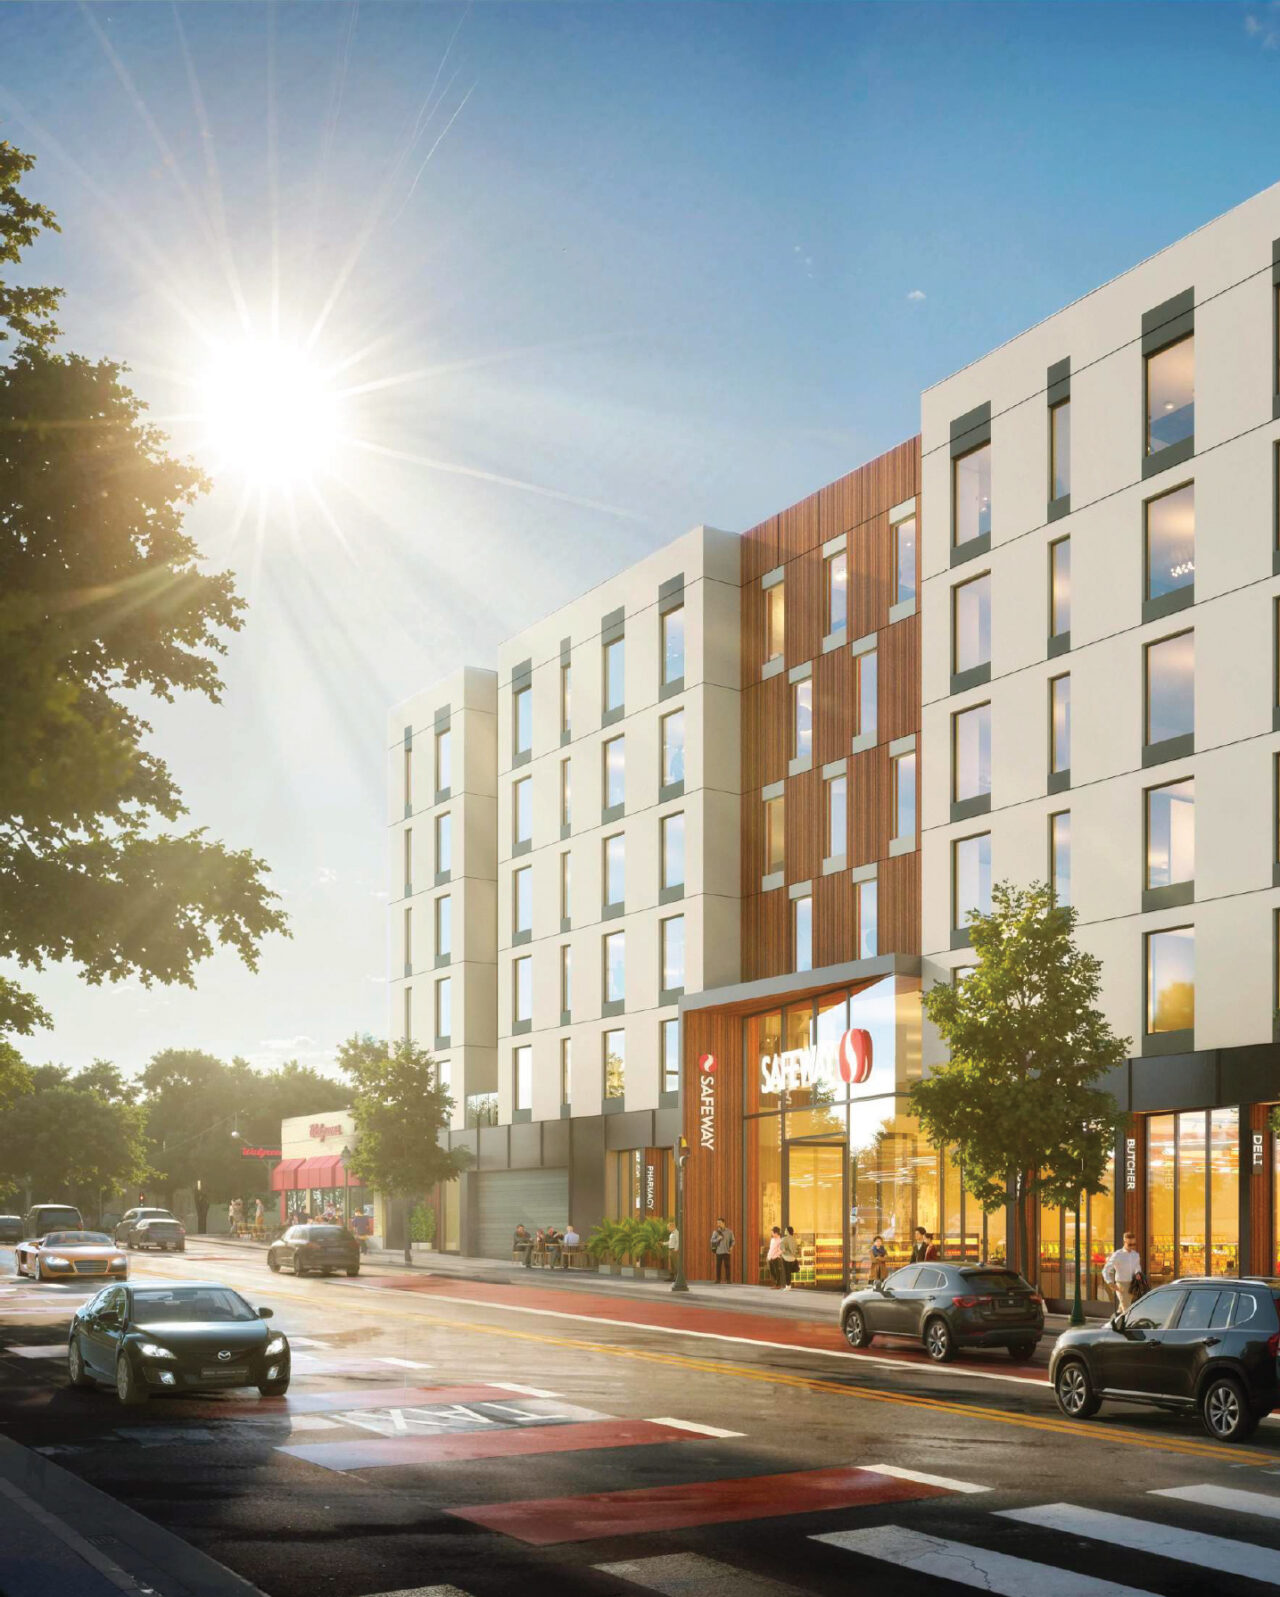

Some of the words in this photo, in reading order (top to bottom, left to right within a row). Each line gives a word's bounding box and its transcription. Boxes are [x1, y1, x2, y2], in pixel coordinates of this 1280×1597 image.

[701, 1076, 714, 1151] SAFEWAY
[1127, 1138, 1135, 1190] BUTCHER
[1253, 1135, 1263, 1165] DELI
[647, 1166, 655, 1210] PHARMACY
